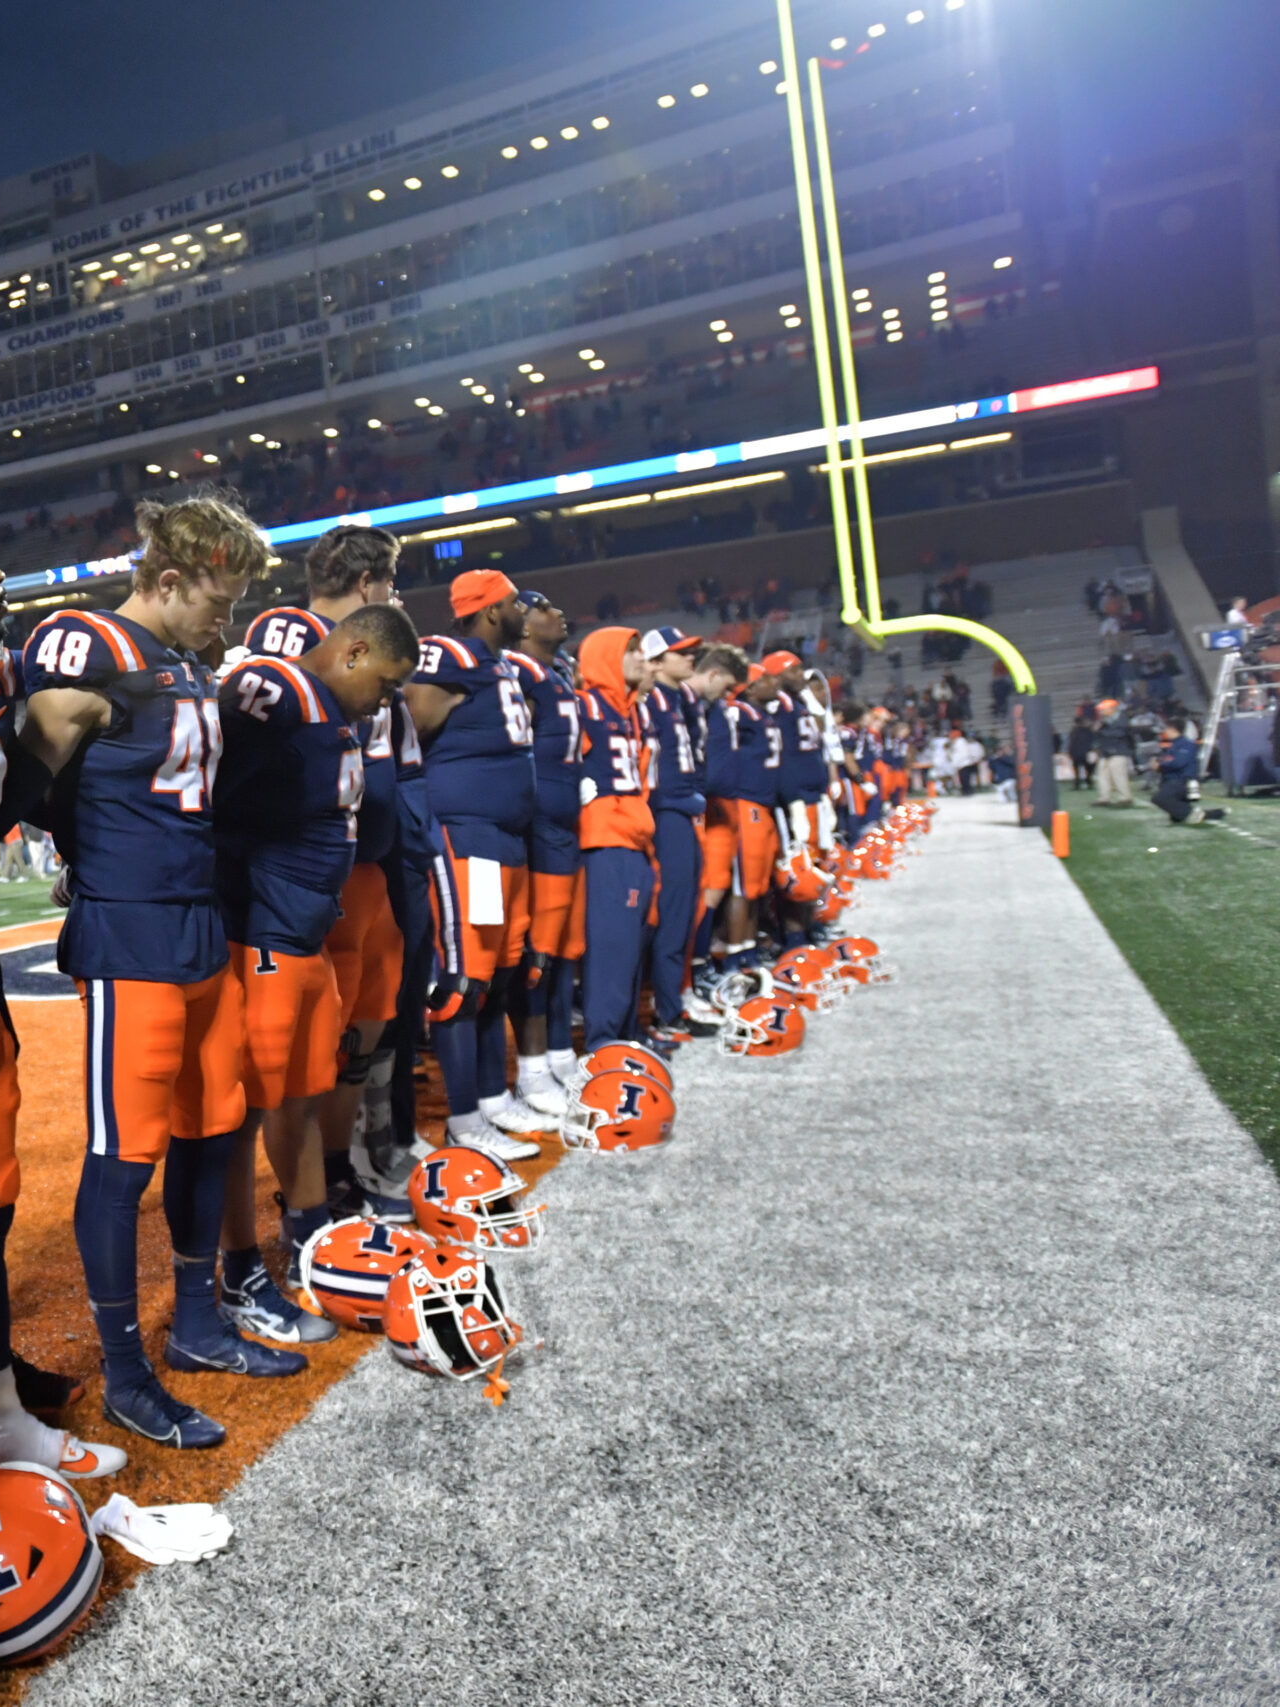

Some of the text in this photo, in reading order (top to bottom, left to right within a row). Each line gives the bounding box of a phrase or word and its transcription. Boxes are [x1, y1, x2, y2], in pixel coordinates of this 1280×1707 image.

[52, 129, 396, 254] HOME OF THE FIGHTING ILLINI
[7, 308, 124, 350] CHAMPIONS
[36, 628, 92, 677] 48
[263, 617, 308, 658] 66
[237, 671, 283, 722] 92
[499, 678, 534, 746] 6
[614, 1082, 647, 1121] I
[423, 1158, 450, 1203] I
